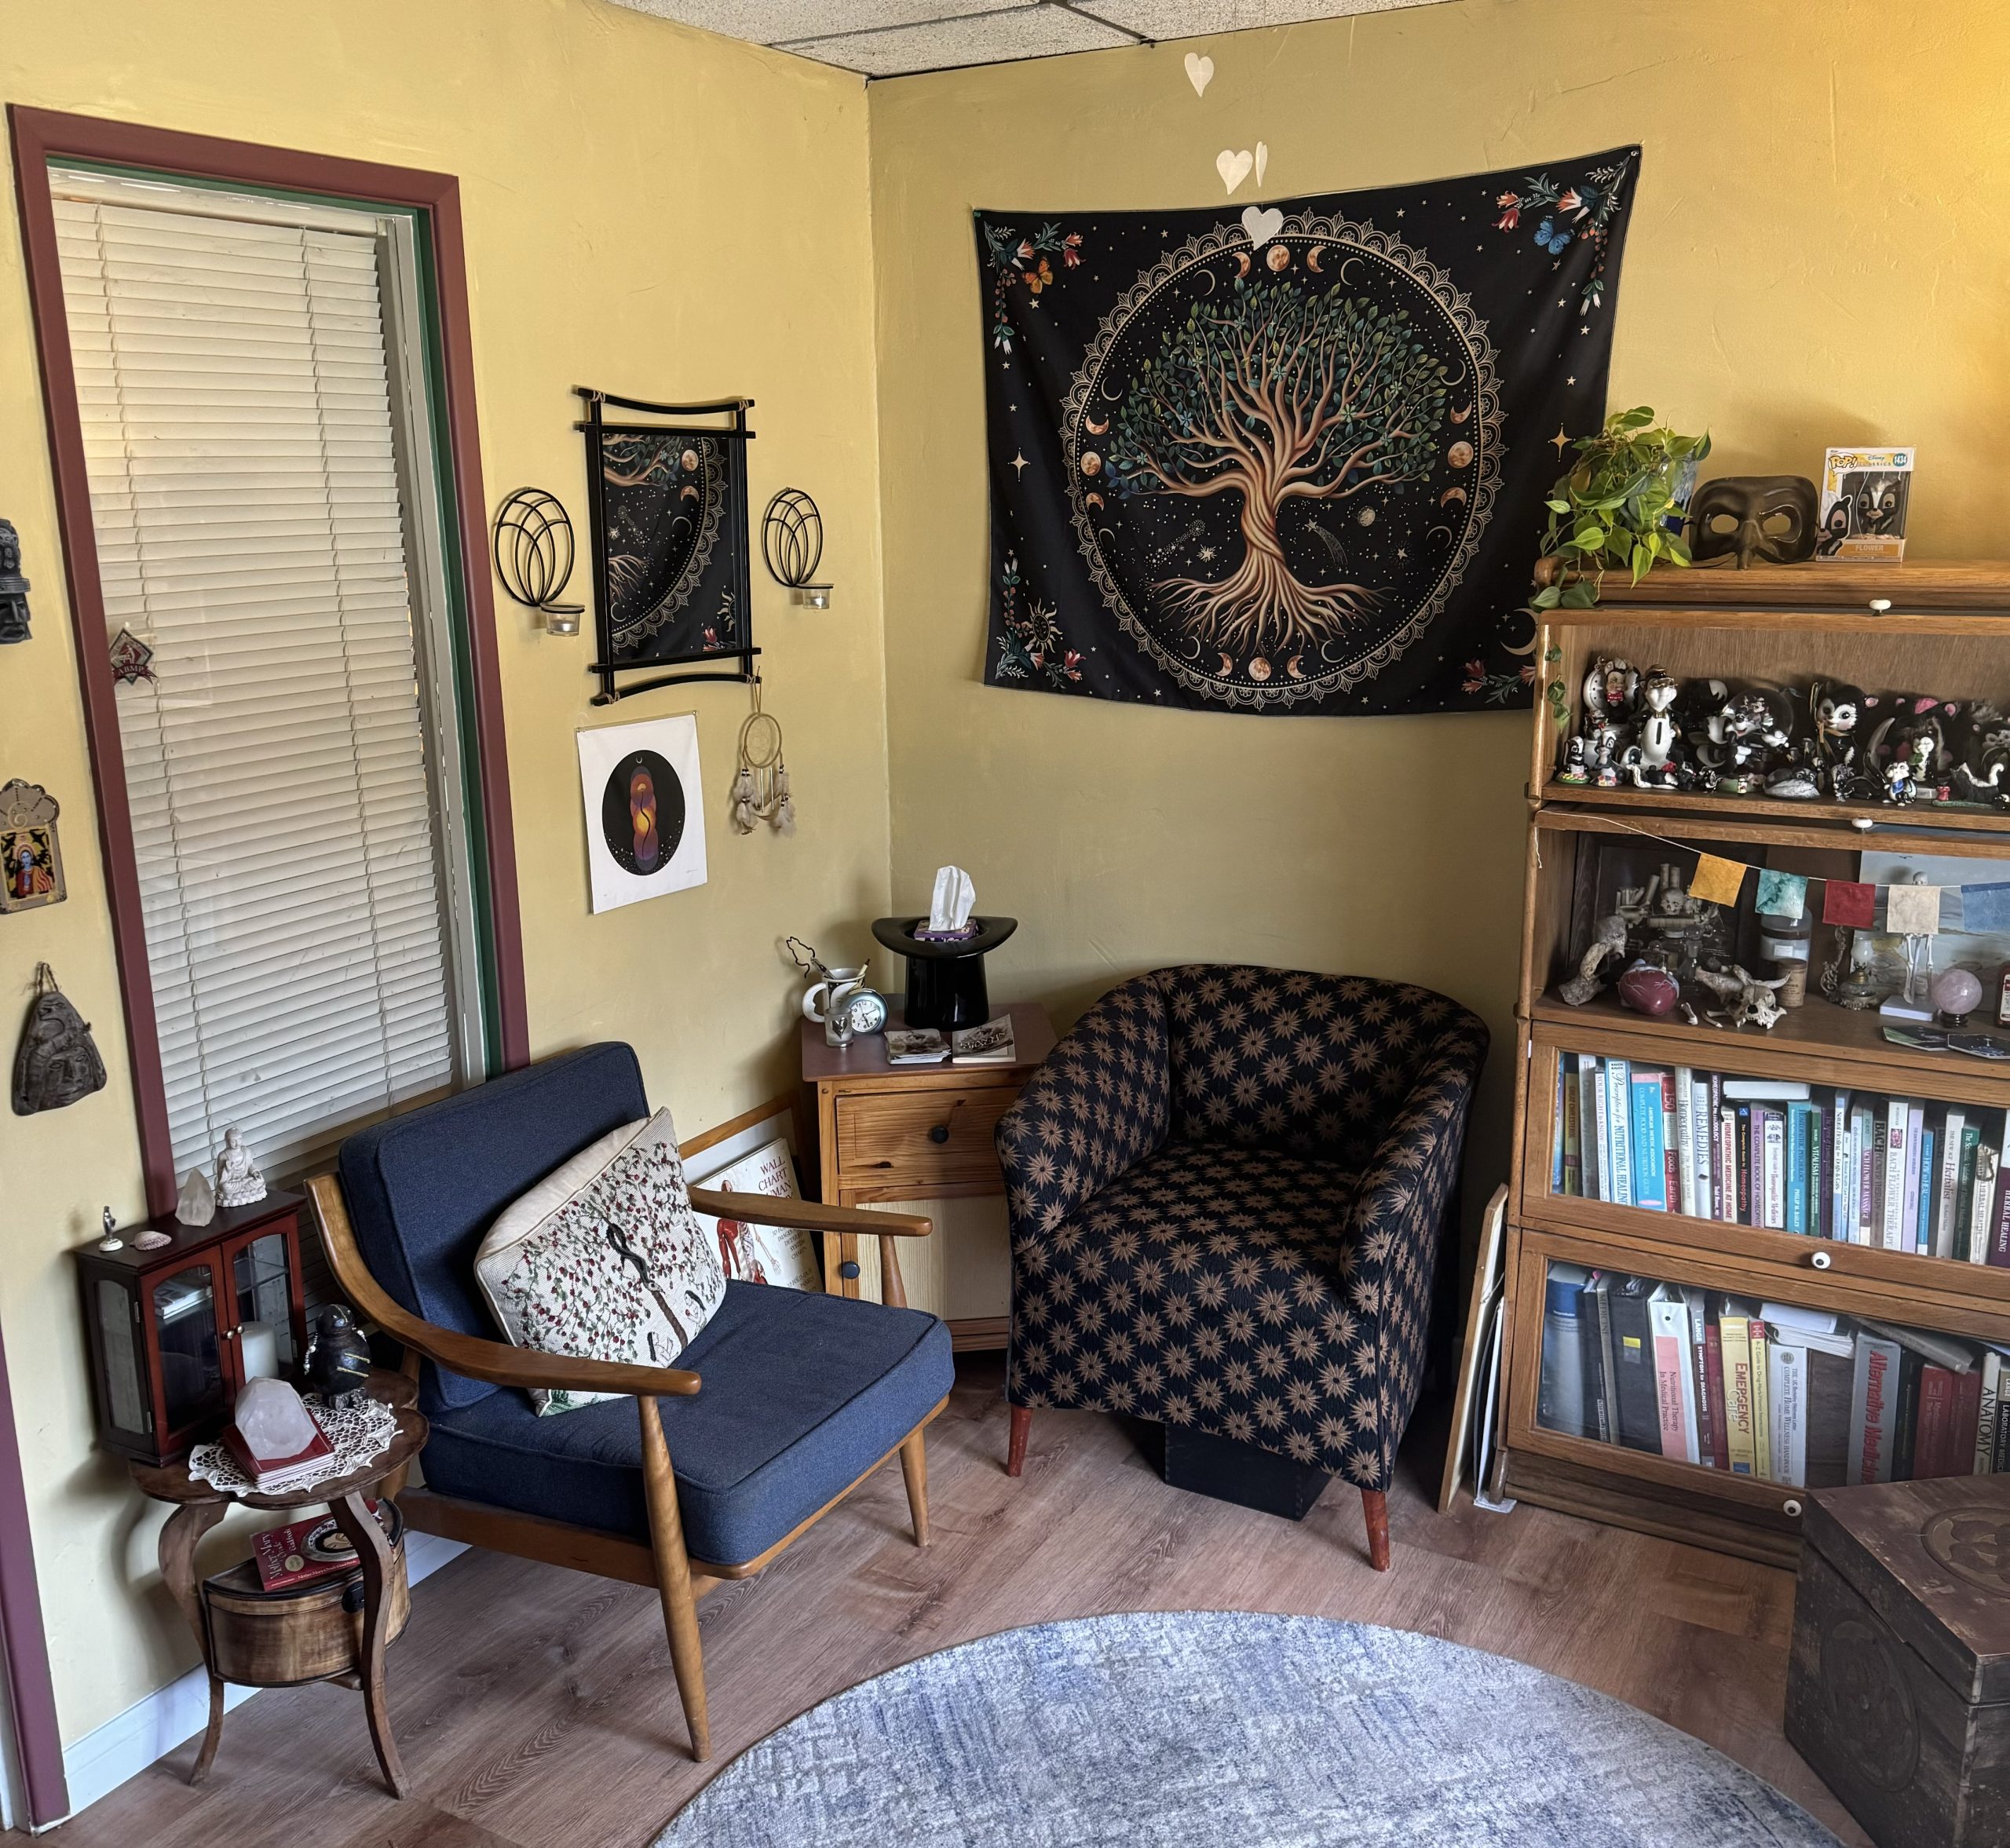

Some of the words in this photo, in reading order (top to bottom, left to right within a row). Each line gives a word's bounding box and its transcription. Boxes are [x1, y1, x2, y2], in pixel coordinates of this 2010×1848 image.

[1829, 455, 1858, 469] POP!
[1893, 455, 1907, 466] 1434
[1610, 1072, 1625, 1112] Prescription
[1665, 1092, 1675, 1108] 150
[1612, 1112, 1624, 1123] for
[1678, 1100, 1690, 1146] Homeopathy
[1614, 1125, 1626, 1172] NUTRITIONAL
[1695, 1110, 1708, 1164] REMEDIES
[1874, 1122, 1884, 1152] BACH
[760, 1156, 785, 1174] WALL
[1667, 1152, 1677, 1172] Foods
[758, 1167, 788, 1191] CHART
[1668, 1180, 1679, 1203] Earth
[1888, 1174, 1896, 1208] FLOWER
[1920, 1180, 1929, 1195] HEAL
[1942, 1162, 1955, 1200] Herbalist
[1862, 1189, 1870, 1218] MASSAGE
[1885, 1210, 1895, 1246] THERAPY
[1998, 1222, 2009, 1252] HEALING
[1734, 1362, 1751, 1434] EMERGENCY
[1865, 1350, 1887, 1423] Alternative
[1670, 1407, 1679, 1432] Therapy
[1726, 1388, 1742, 1422] Care
[1783, 1397, 1793, 1415] HOME
[1783, 1416, 1793, 1444] WELLNESS
[1975, 1386, 1996, 1456] ANATOMY
[2000, 1404, 2009, 1446] LABORATORY
